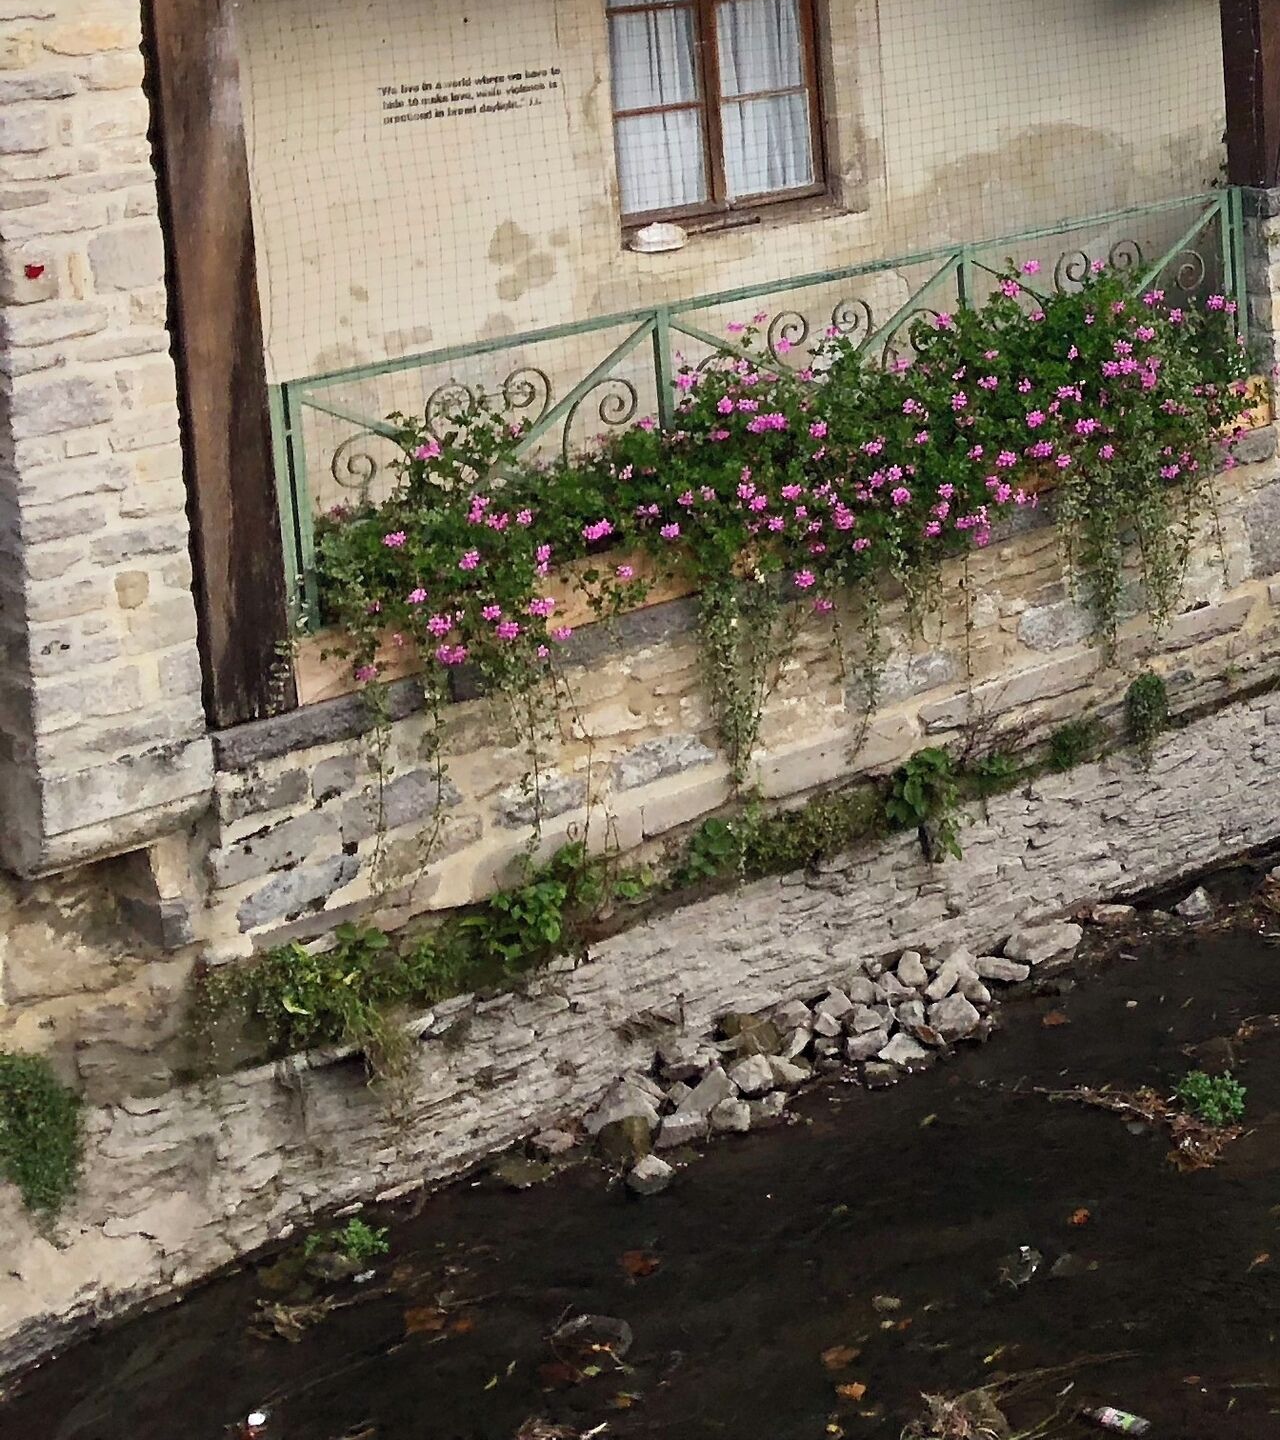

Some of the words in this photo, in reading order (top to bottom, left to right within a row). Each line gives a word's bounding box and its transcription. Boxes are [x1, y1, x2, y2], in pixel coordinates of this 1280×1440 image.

[401, 84, 419, 94] live
[422, 82, 432, 91] in
[444, 77, 471, 88] world
[475, 75, 504, 85] where
[525, 70, 547, 78] have
[551, 66, 560, 75] to
[383, 99, 404, 110] hide
[408, 97, 418, 106] to
[421, 94, 448, 104] make
[476, 88, 501, 97] while
[506, 83, 545, 95] violence
[435, 109, 444, 117] in
[448, 105, 476, 116] broad
